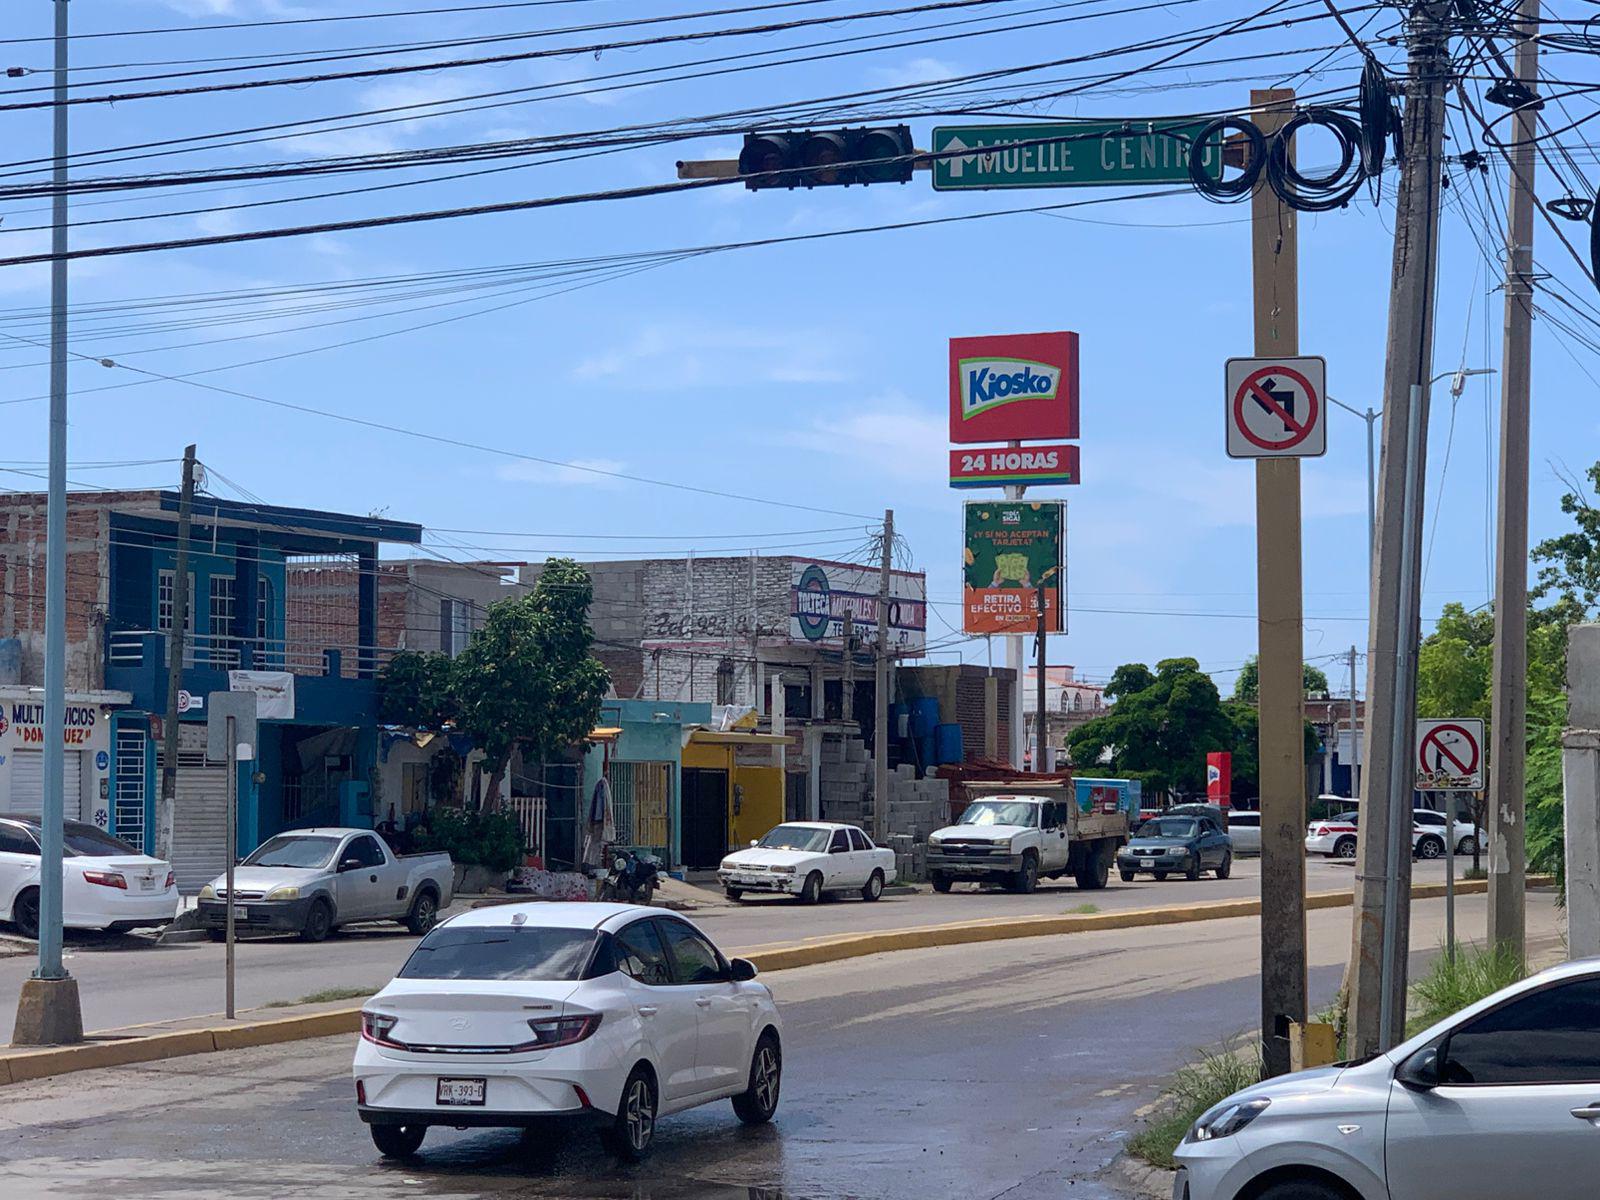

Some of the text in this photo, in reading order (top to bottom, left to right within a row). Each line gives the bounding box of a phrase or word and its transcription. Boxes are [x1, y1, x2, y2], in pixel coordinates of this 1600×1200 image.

[977, 138, 1075, 174] MUELLE
[969, 366, 1052, 406] Kiosko
[961, 451, 1059, 472] 24 HORAS
[995, 530, 1008, 538] NO
[1010, 529, 1050, 538] ACEPTAN
[983, 594, 1022, 604] RETIRA
[970, 603, 1022, 613] EFECTIVO
